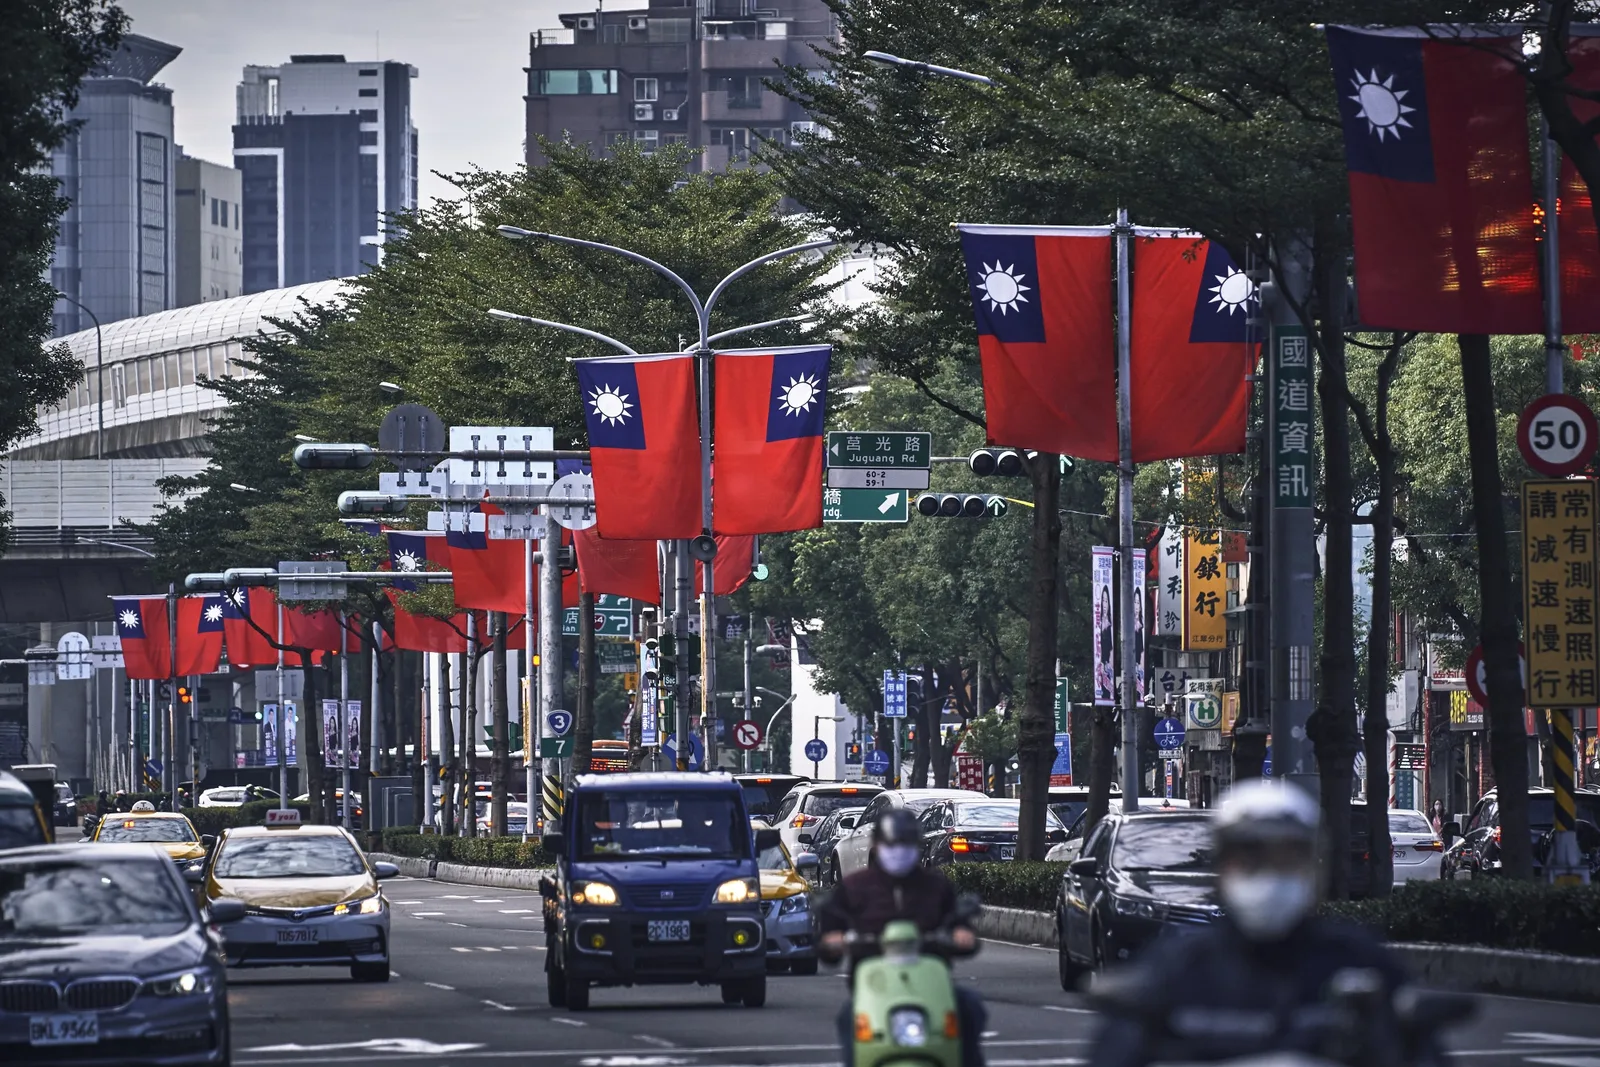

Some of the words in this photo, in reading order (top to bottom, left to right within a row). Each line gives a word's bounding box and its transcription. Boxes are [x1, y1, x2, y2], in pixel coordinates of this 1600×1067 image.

[1279, 336, 1308, 497] 國道資訊
[846, 435, 920, 452] 莒光路
[1533, 420, 1580, 450] 50
[849, 453, 895, 464] Juguang
[902, 454, 917, 463] Rd.
[823, 488, 841, 505] 橋
[1528, 490, 1562, 699] 請減速慢行
[1560, 488, 1596, 698] 常有測速照相
[565, 611, 579, 624] 店
[554, 715, 565, 729] 3
[555, 740, 566, 755] 7
[278, 812, 298, 821] yoxi
